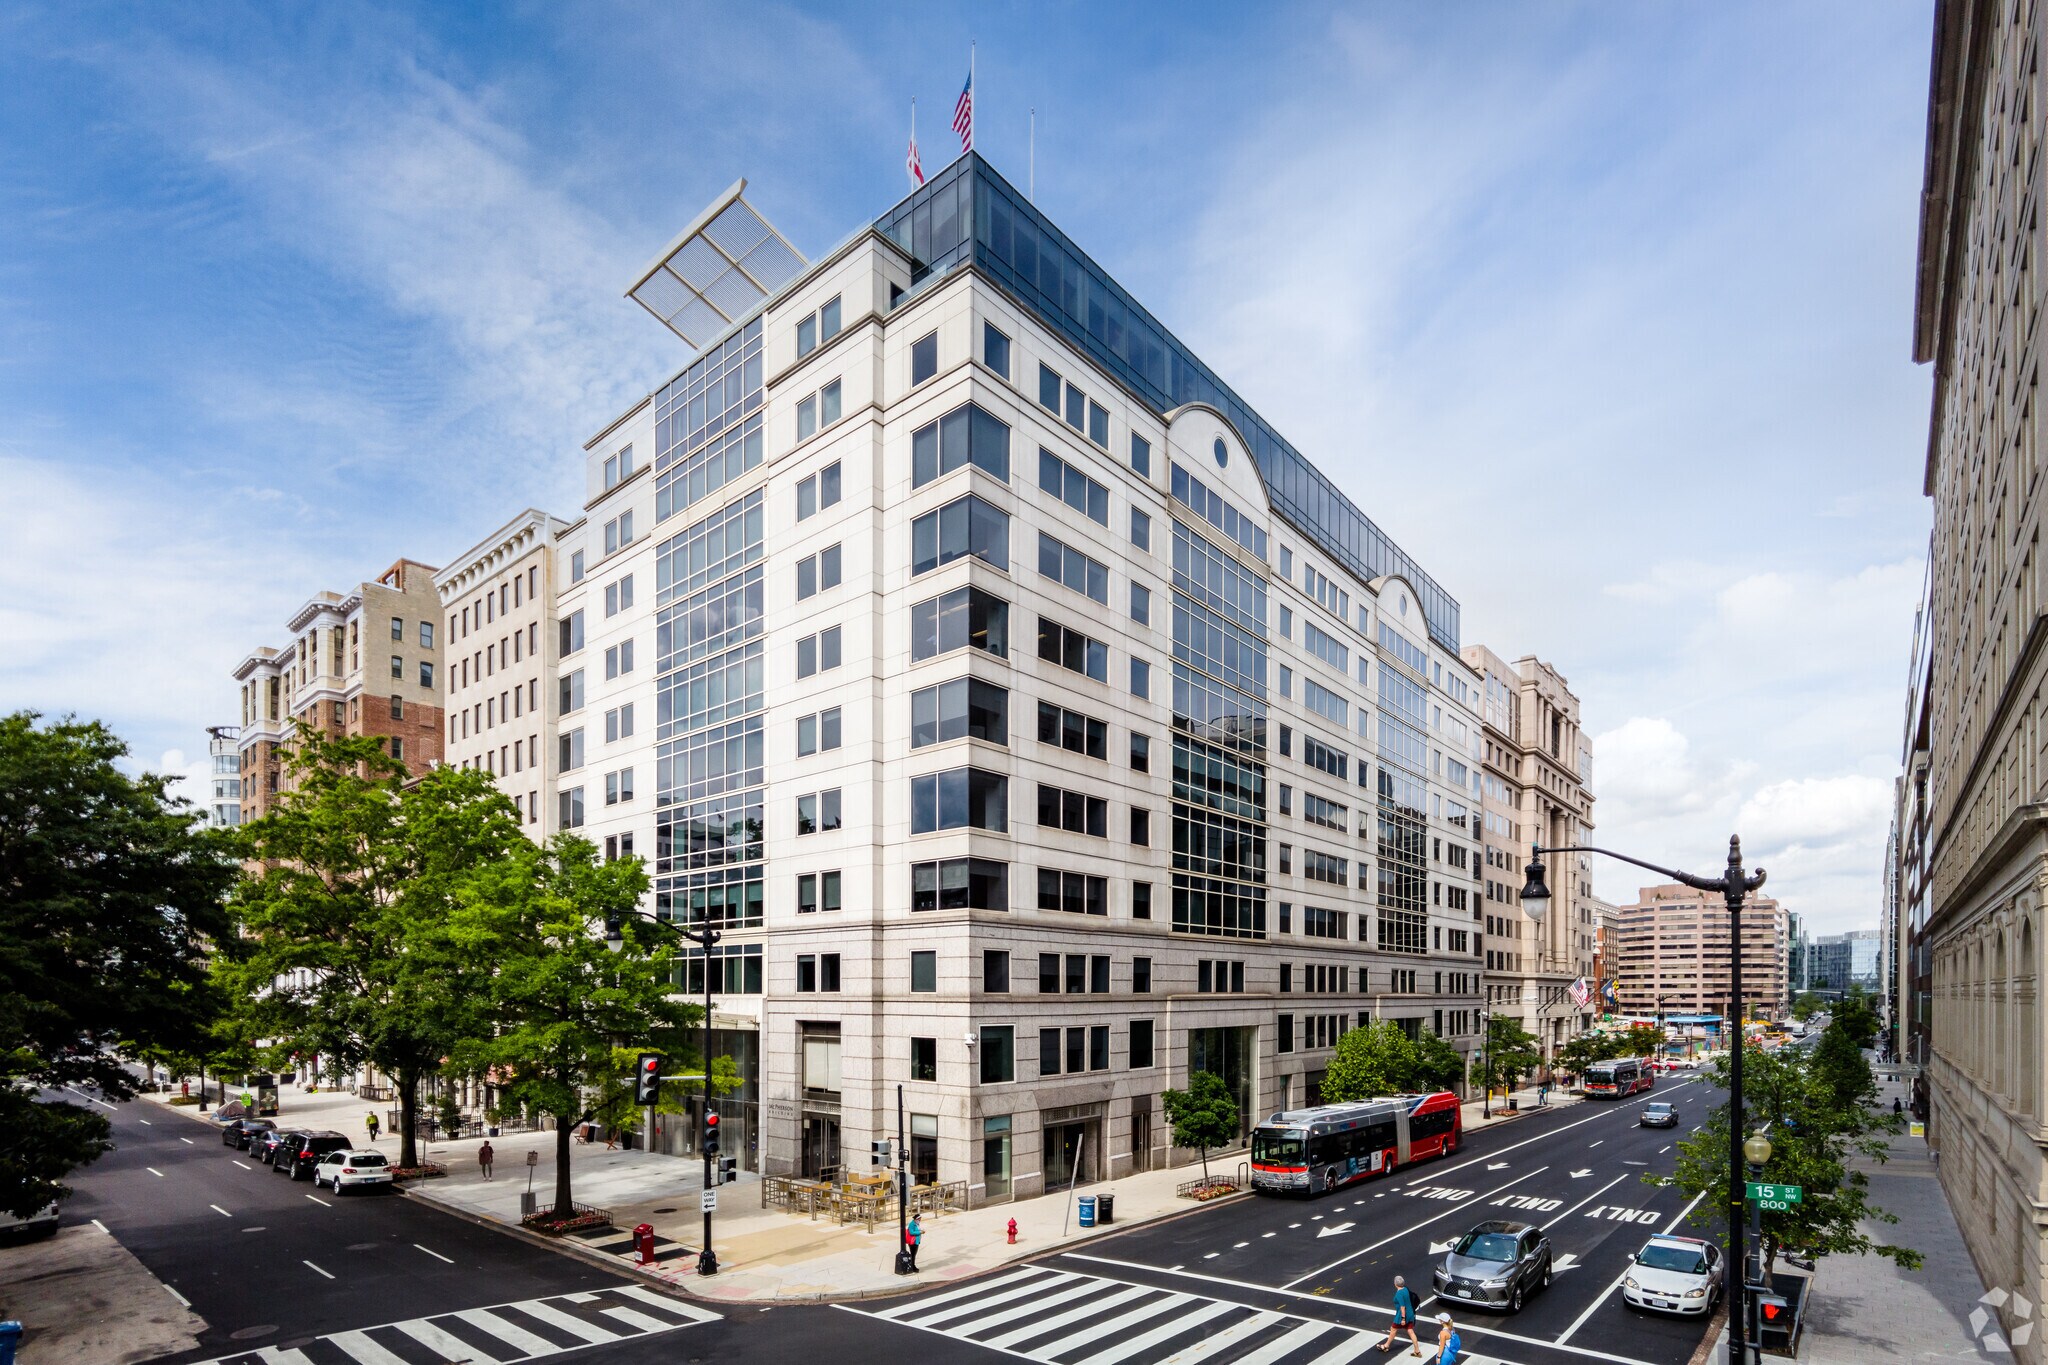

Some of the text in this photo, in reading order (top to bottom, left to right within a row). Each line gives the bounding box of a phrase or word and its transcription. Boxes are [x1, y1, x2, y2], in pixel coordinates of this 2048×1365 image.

[1403, 1186, 1475, 1201] ONLY
[1755, 1185, 1775, 1198] 15
[1488, 1194, 1564, 1212] ONLY
[1760, 1199, 1788, 1210] 800
[1583, 1205, 1662, 1225] ONLY
